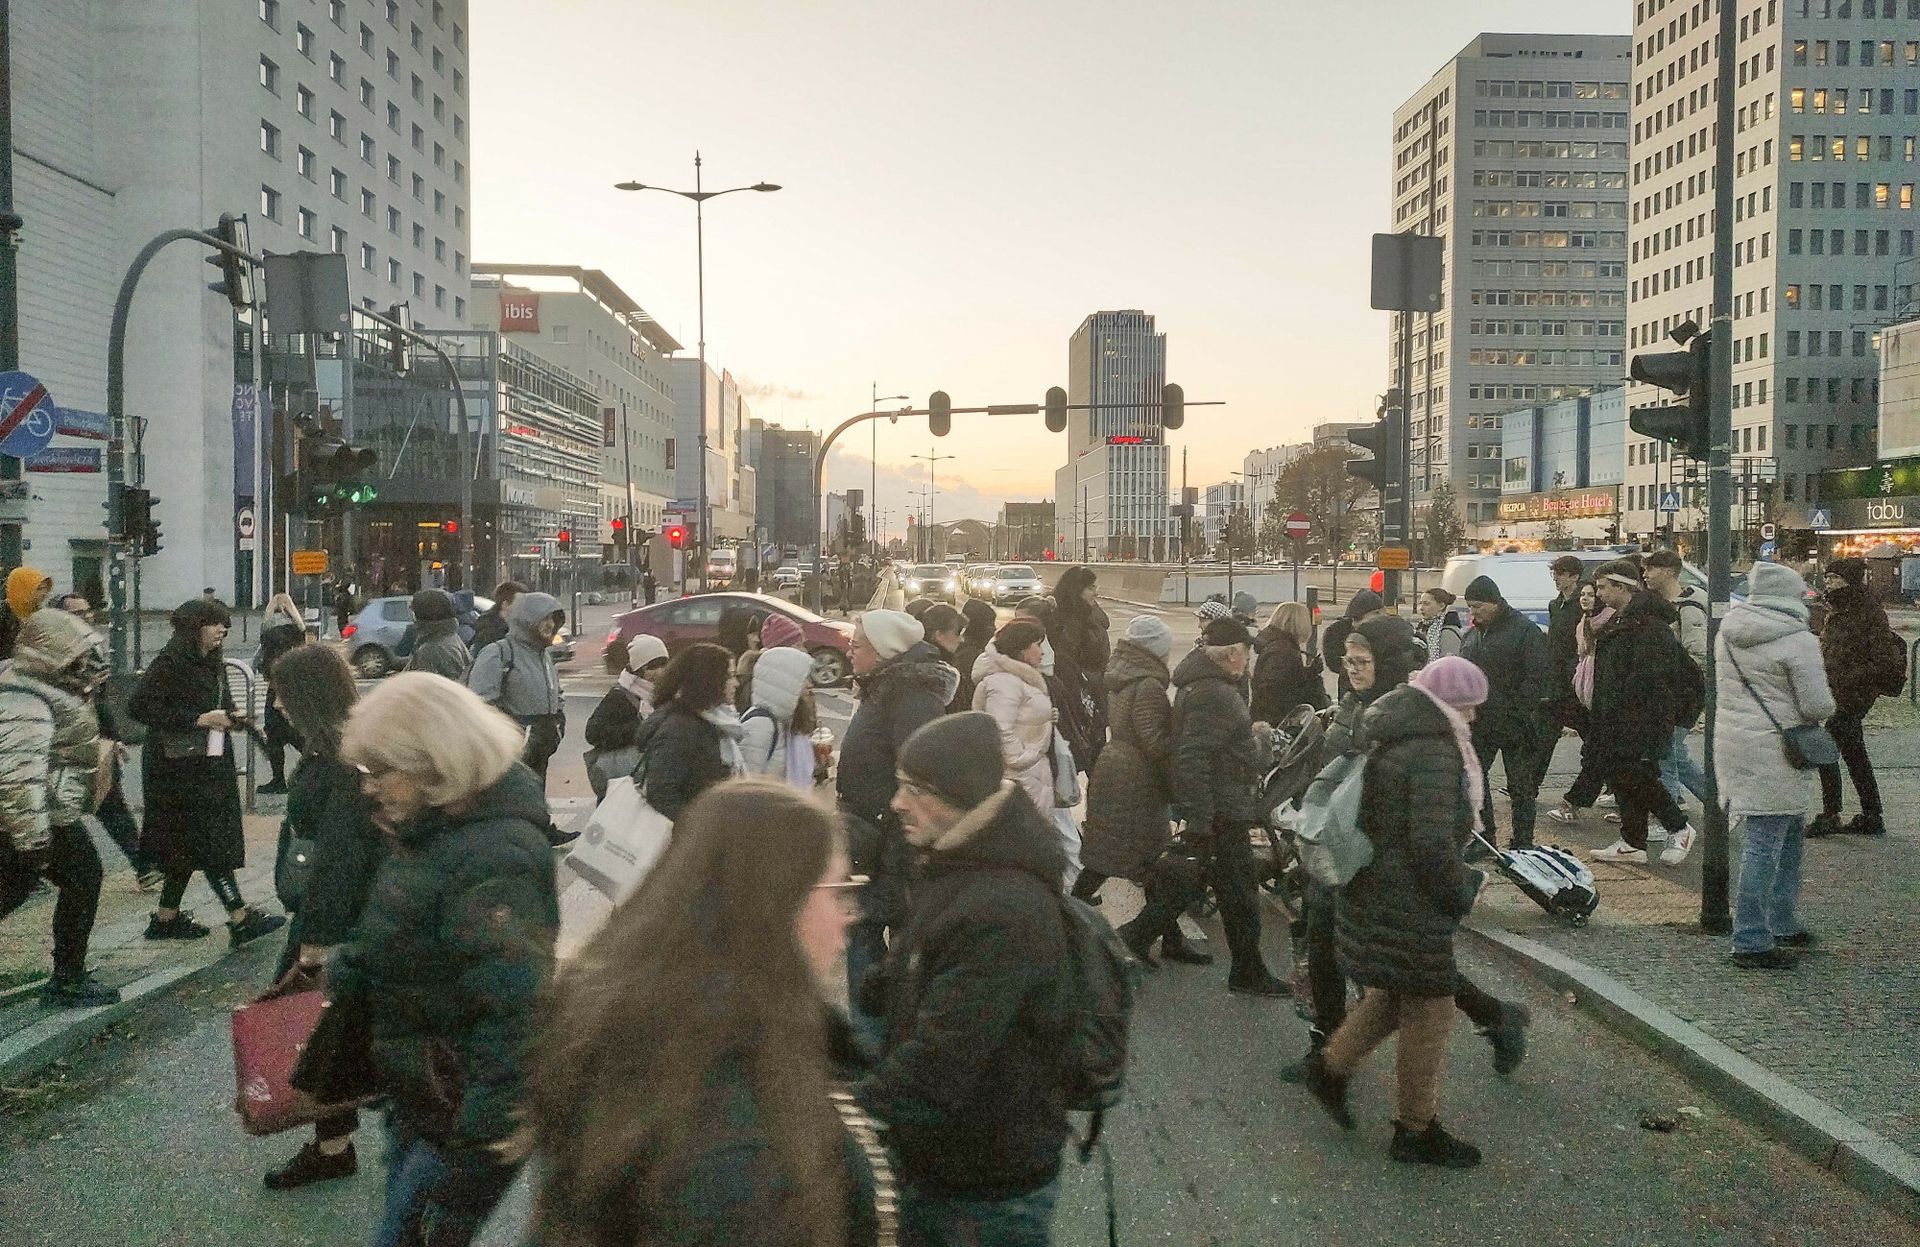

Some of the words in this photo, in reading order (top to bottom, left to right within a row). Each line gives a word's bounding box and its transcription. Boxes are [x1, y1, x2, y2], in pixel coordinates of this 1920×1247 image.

[505, 303, 533, 319] ibis
[1581, 493, 1613, 508] Hotel's
[1867, 499, 1904, 520] tabu
